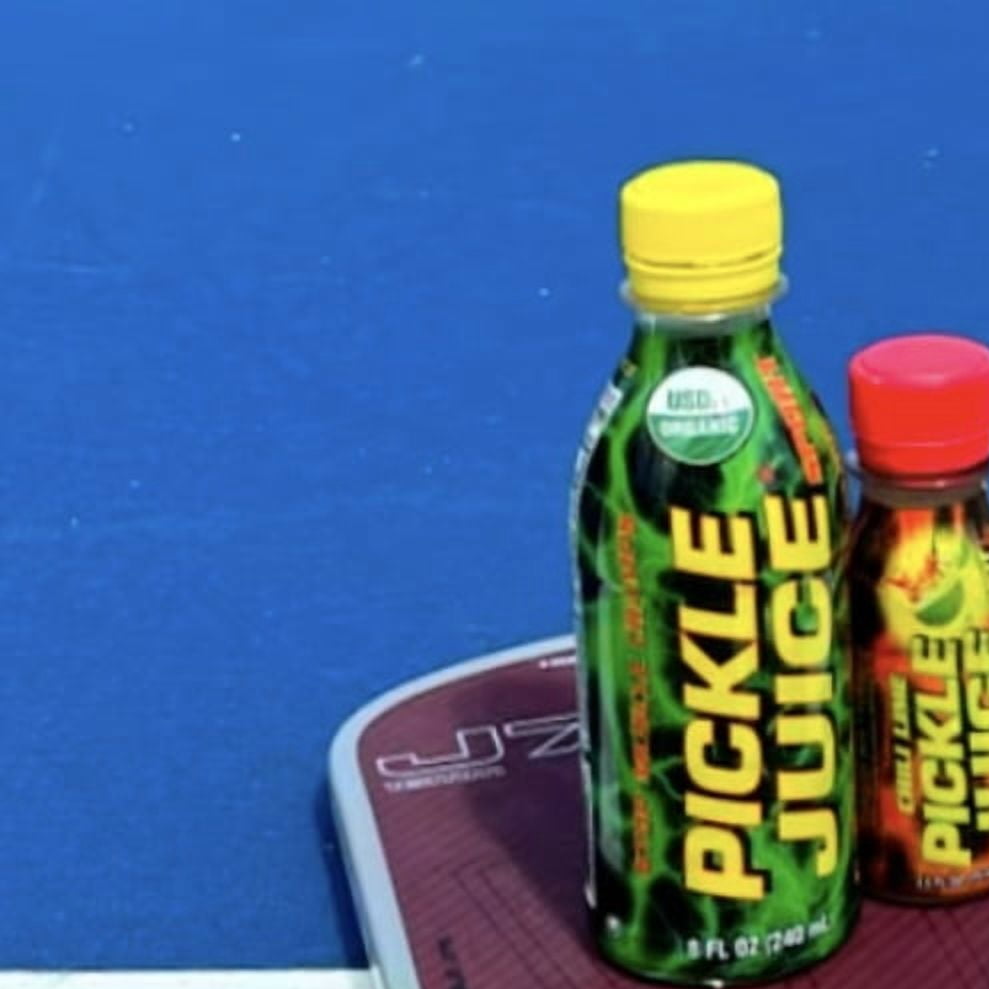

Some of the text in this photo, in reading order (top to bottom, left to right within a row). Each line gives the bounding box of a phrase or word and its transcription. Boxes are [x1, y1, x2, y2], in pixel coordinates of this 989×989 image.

[669, 505, 765, 901] PICKLE
[763, 494, 838, 877] JUICE
[911, 633, 972, 868] PICKLE
[706, 938, 730, 960] FL
